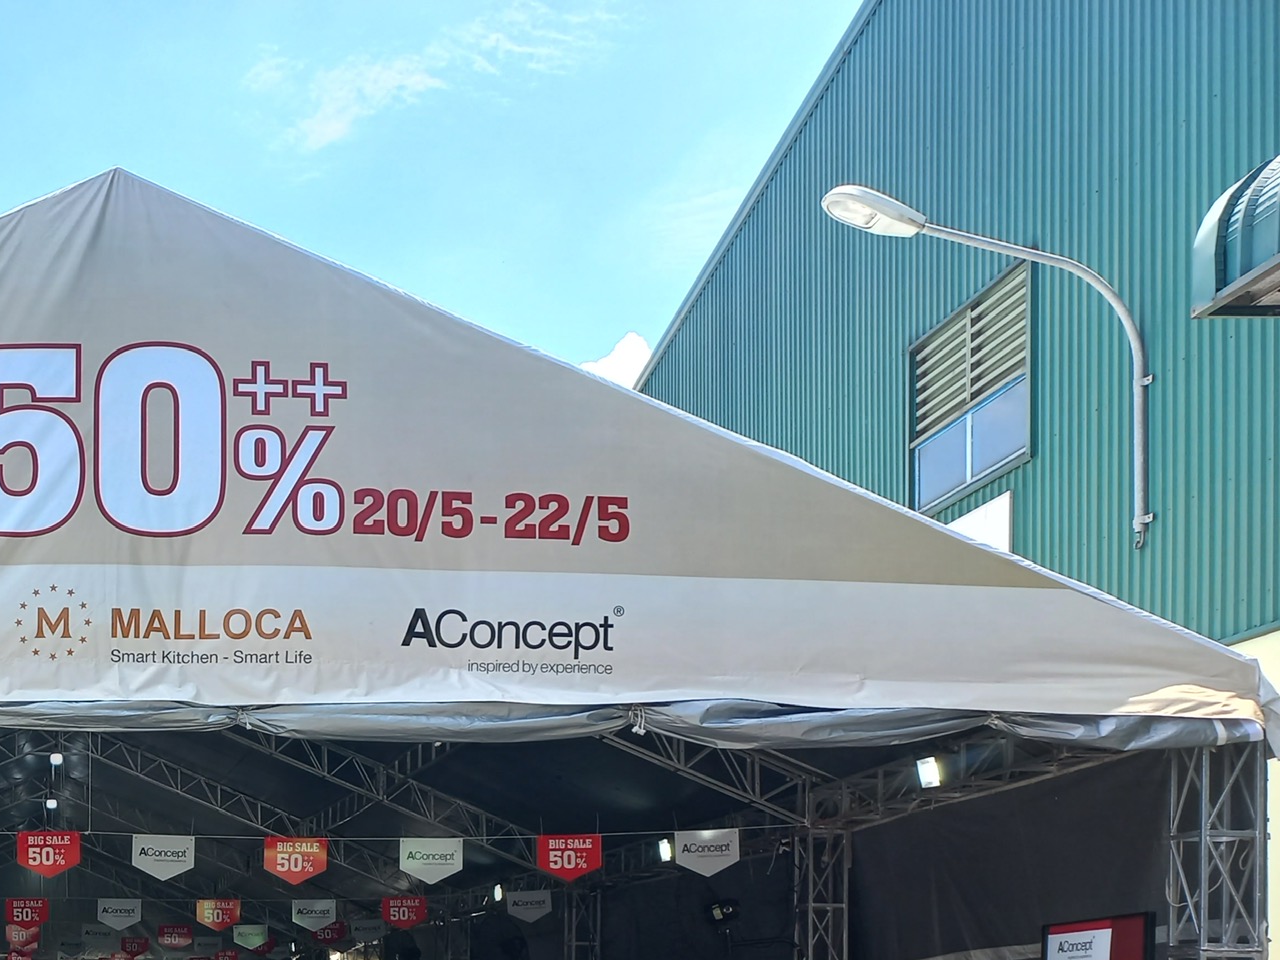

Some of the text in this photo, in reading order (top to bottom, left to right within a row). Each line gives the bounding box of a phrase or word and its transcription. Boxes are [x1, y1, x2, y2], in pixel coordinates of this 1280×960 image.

[34, 607, 73, 638] M
[111, 608, 313, 640] MALLOCA
[111, 649, 157, 664] Smart
[162, 650, 218, 665] Kitchen
[233, 650, 280, 665] Smart
[285, 650, 313, 665] Life
[468, 659, 613, 676] inspired by experience
[28, 836, 70, 845] BIG SALE
[276, 842, 319, 852] BIG SALE
[549, 839, 592, 848] BIG SALE
[1057, 939, 1093, 954] AConcept
